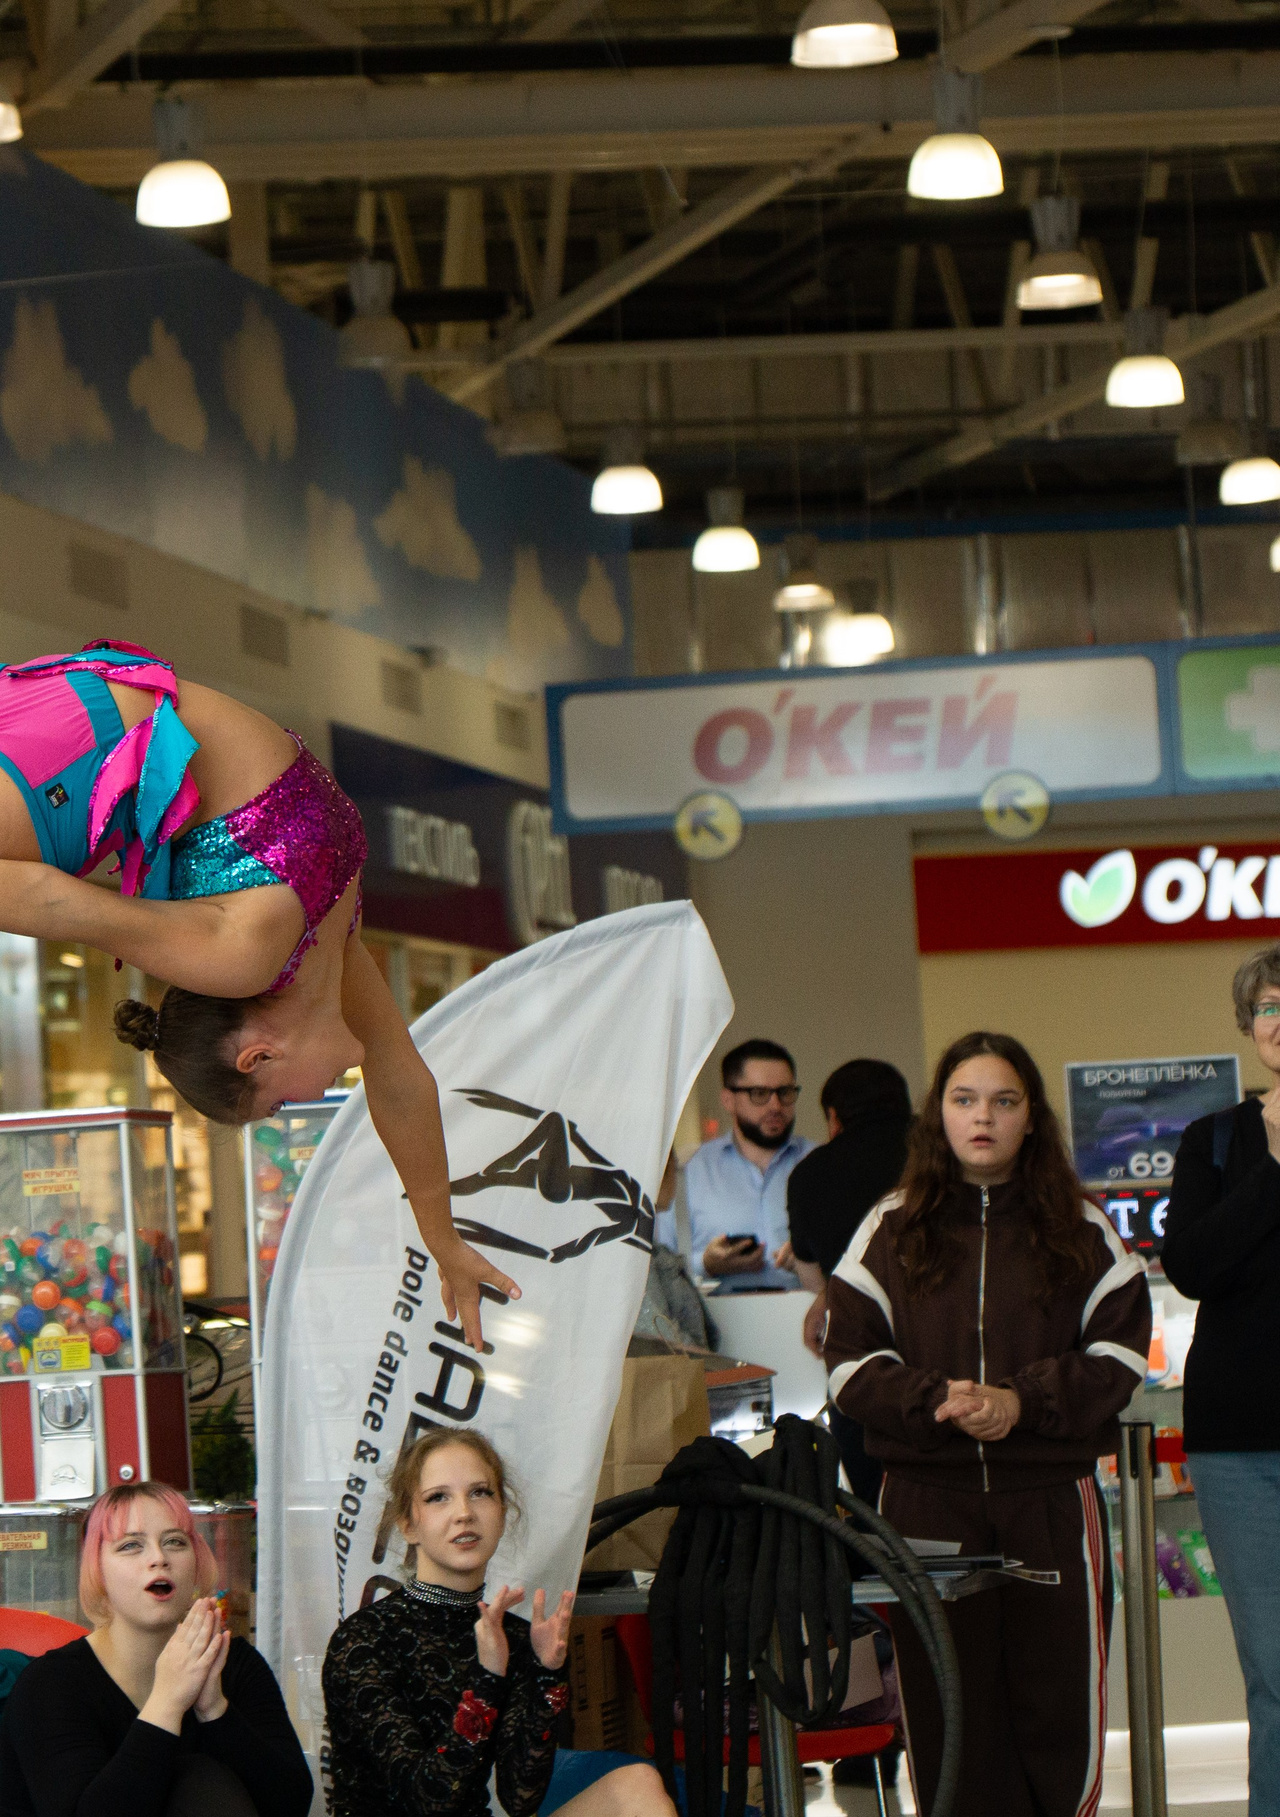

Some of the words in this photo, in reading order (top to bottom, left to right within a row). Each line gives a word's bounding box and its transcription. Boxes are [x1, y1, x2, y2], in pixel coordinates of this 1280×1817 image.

[694, 674, 1018, 786] О'КЕЙ
[1142, 846, 1280, 925] О'К
[1084, 1062, 1217, 1086] БРОНЕПЛЁНКА
[1129, 1151, 1174, 1178] 69
[32, 1184, 73, 1194] ИГРУШКА
[1107, 1198, 1139, 1238] Т
[392, 1245, 430, 1323] pole
[362, 1330, 409, 1433] dance
[353, 1439, 381, 1465] &
